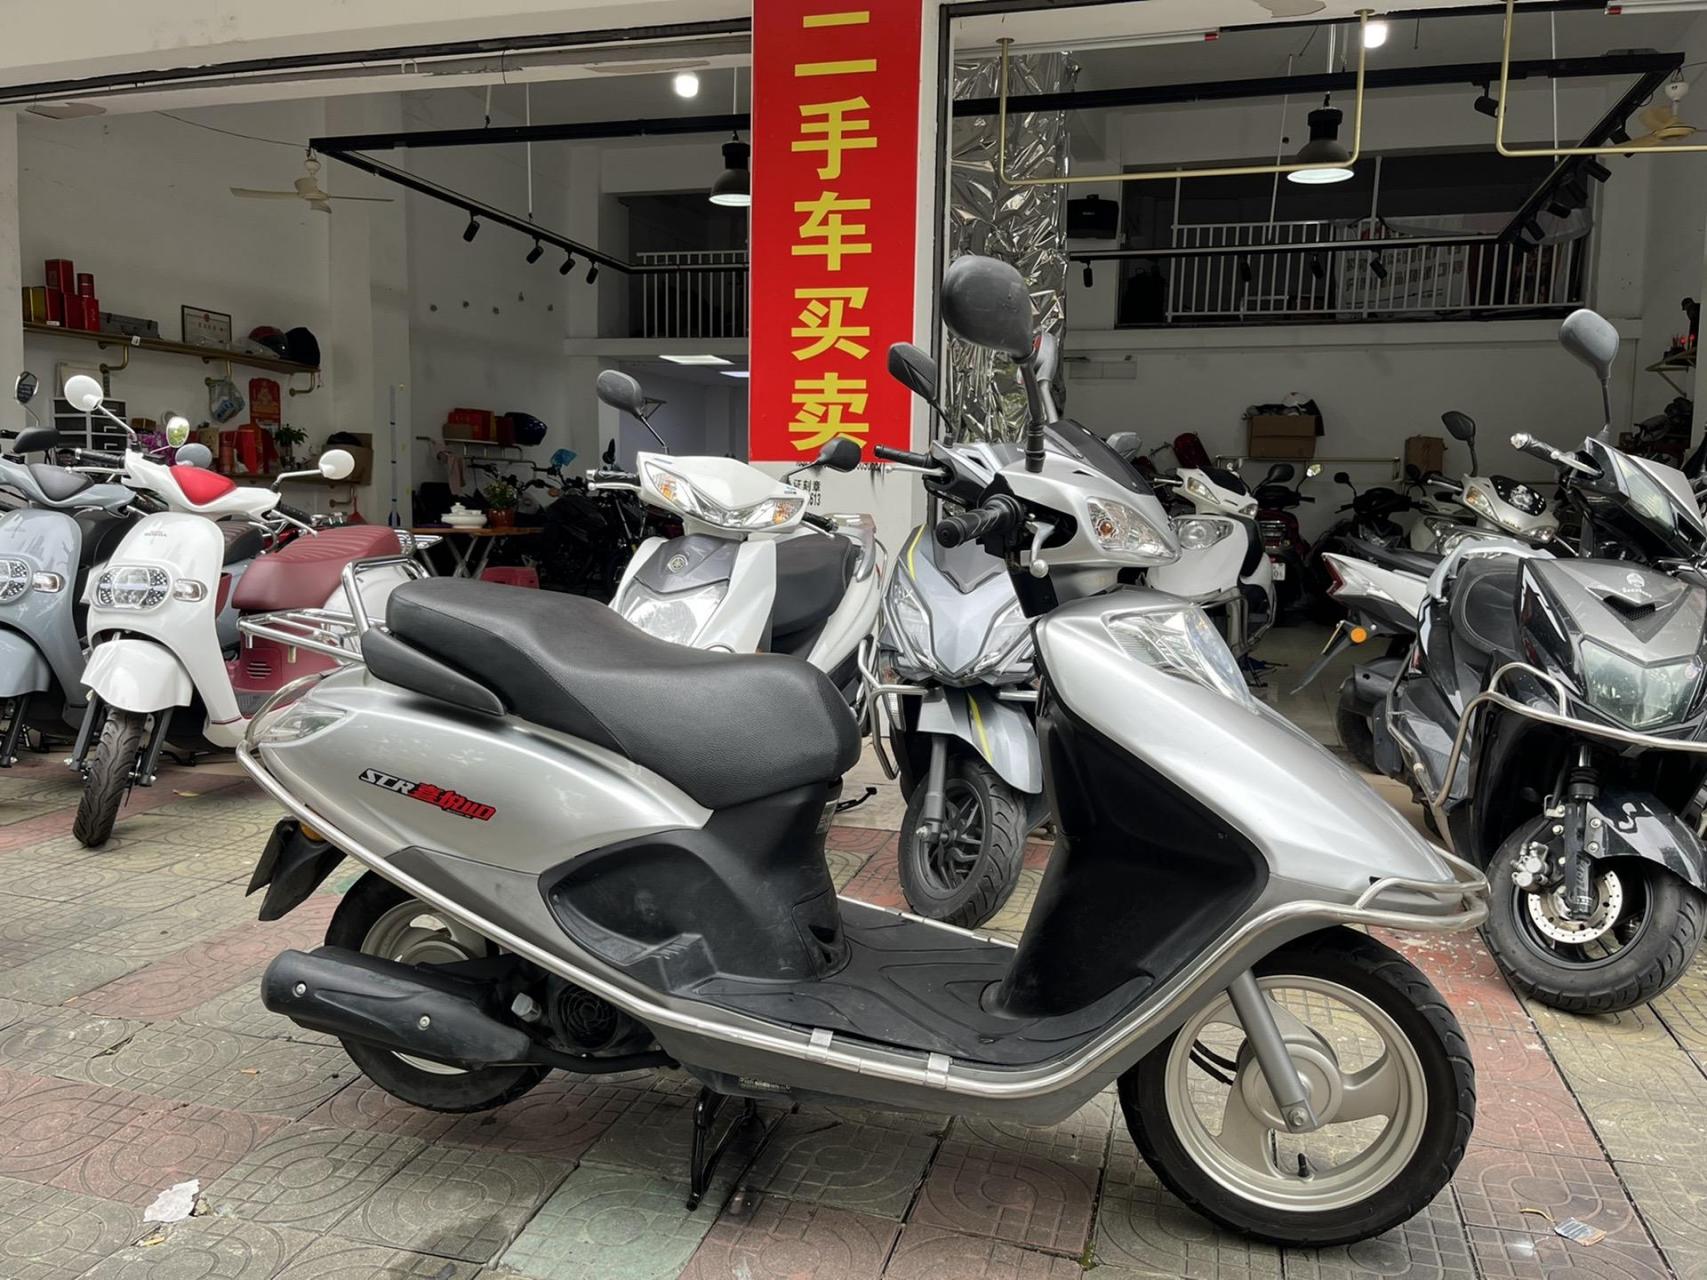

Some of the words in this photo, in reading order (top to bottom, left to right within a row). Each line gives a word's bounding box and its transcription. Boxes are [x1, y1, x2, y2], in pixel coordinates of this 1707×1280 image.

[789, 11, 877, 451] 二手车买卖
